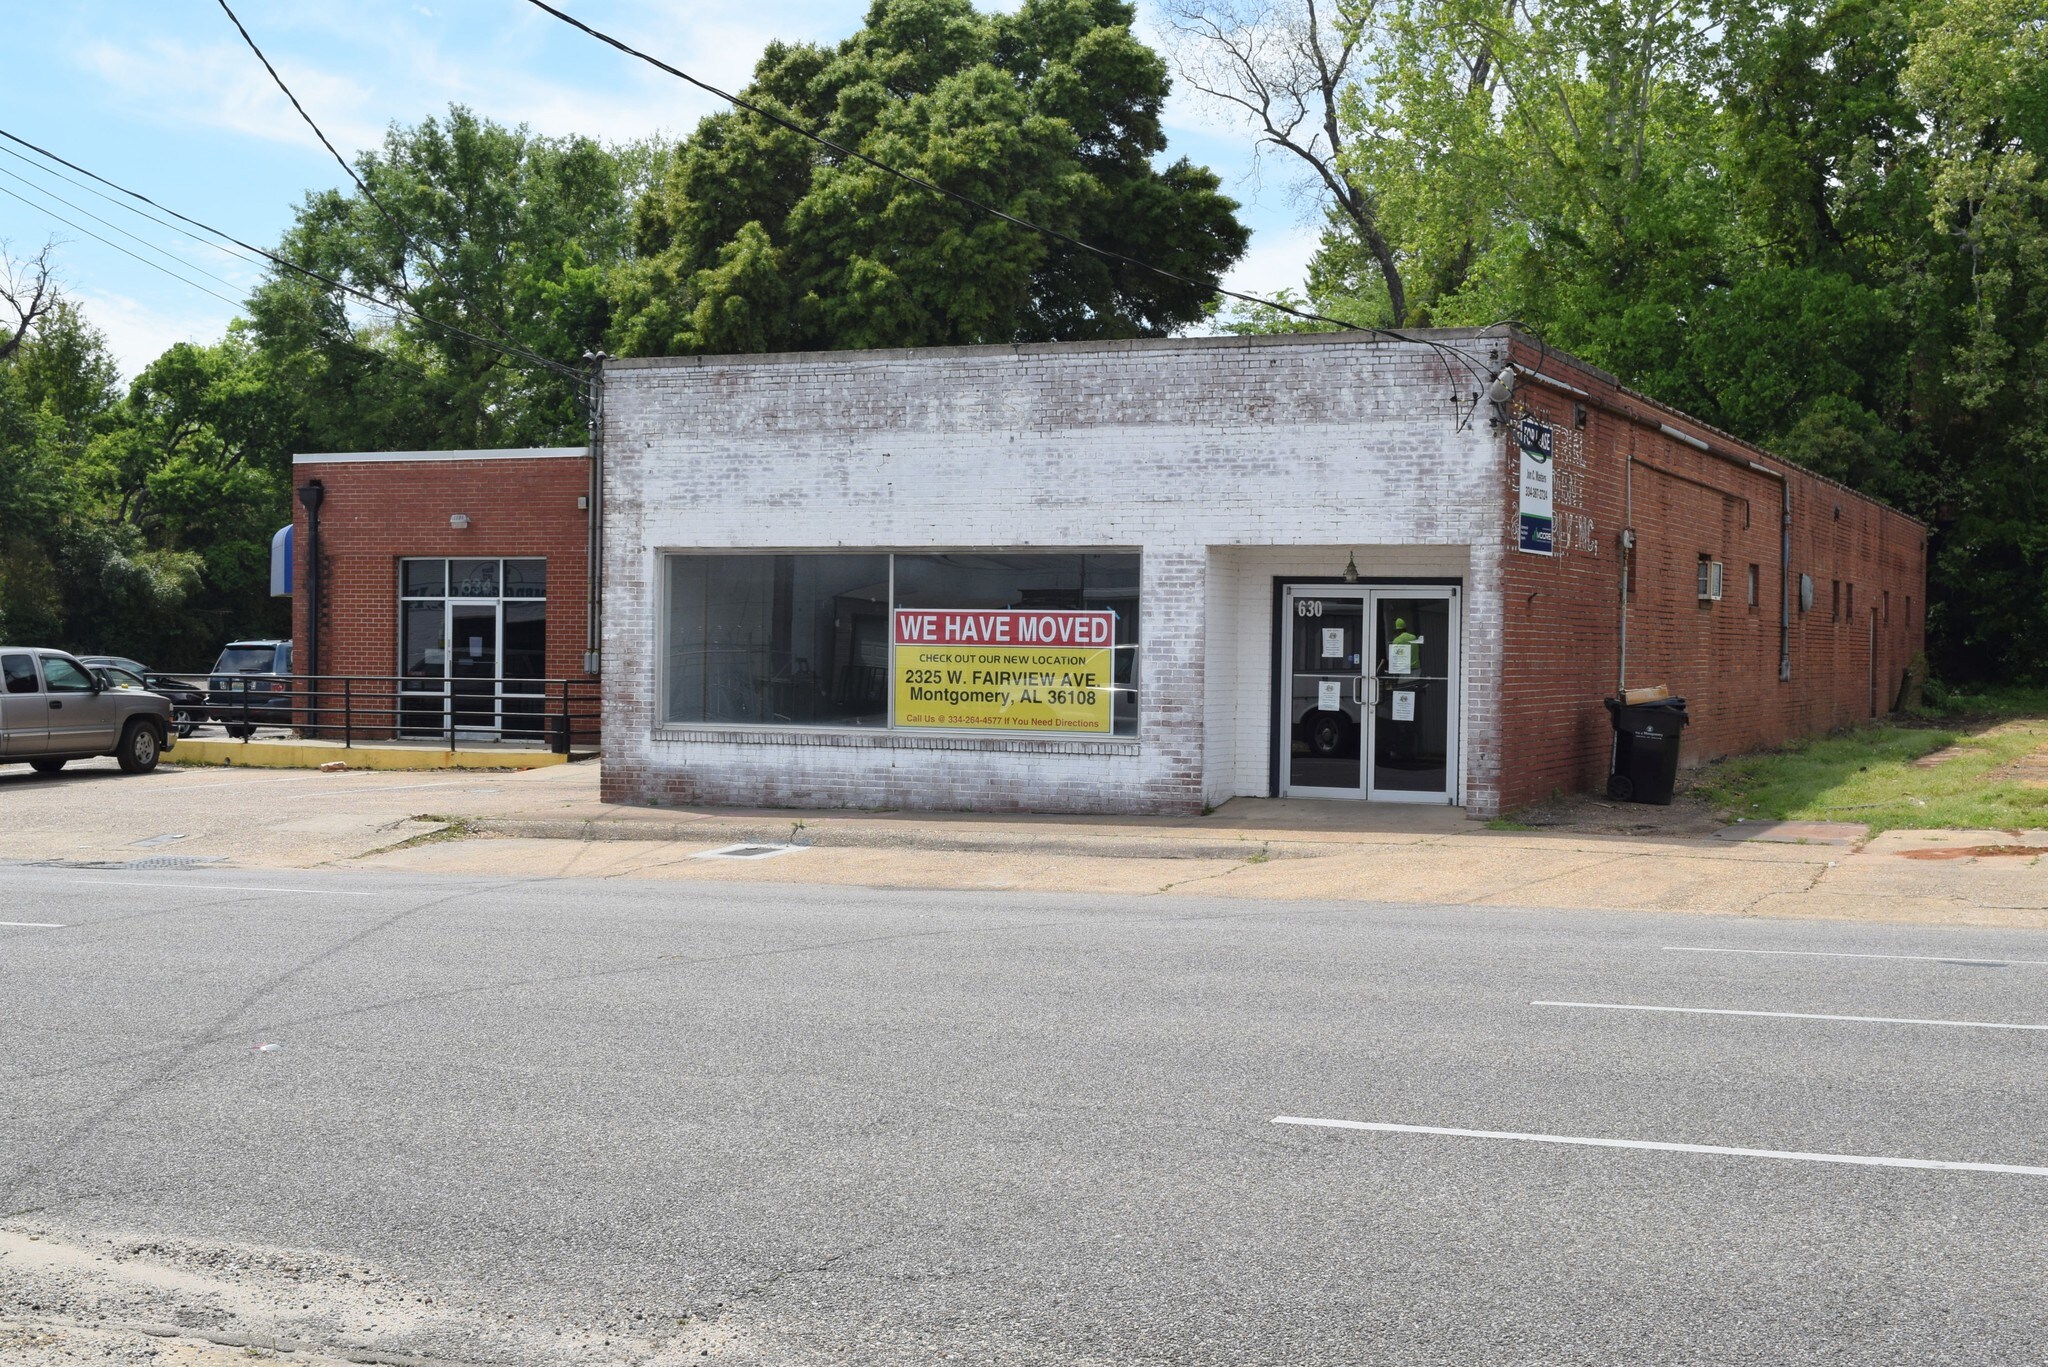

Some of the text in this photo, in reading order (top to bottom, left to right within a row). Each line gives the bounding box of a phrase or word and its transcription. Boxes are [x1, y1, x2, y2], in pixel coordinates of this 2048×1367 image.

[1535, 429, 1551, 450] LASE
[461, 578, 492, 594] 634
[1298, 600, 1323, 617] 630
[900, 615, 1108, 643] WE HAVE MOVED
[919, 653, 1086, 665] CHECK OUT OUR NEW LOCATION
[905, 669, 1101, 687] 2325 W. FAIRVIEW AVE.
[910, 686, 1096, 706] Montgomery, AL 36108
[906, 714, 1099, 728] Call Us @ 334-264-4577 If You Need Directions
